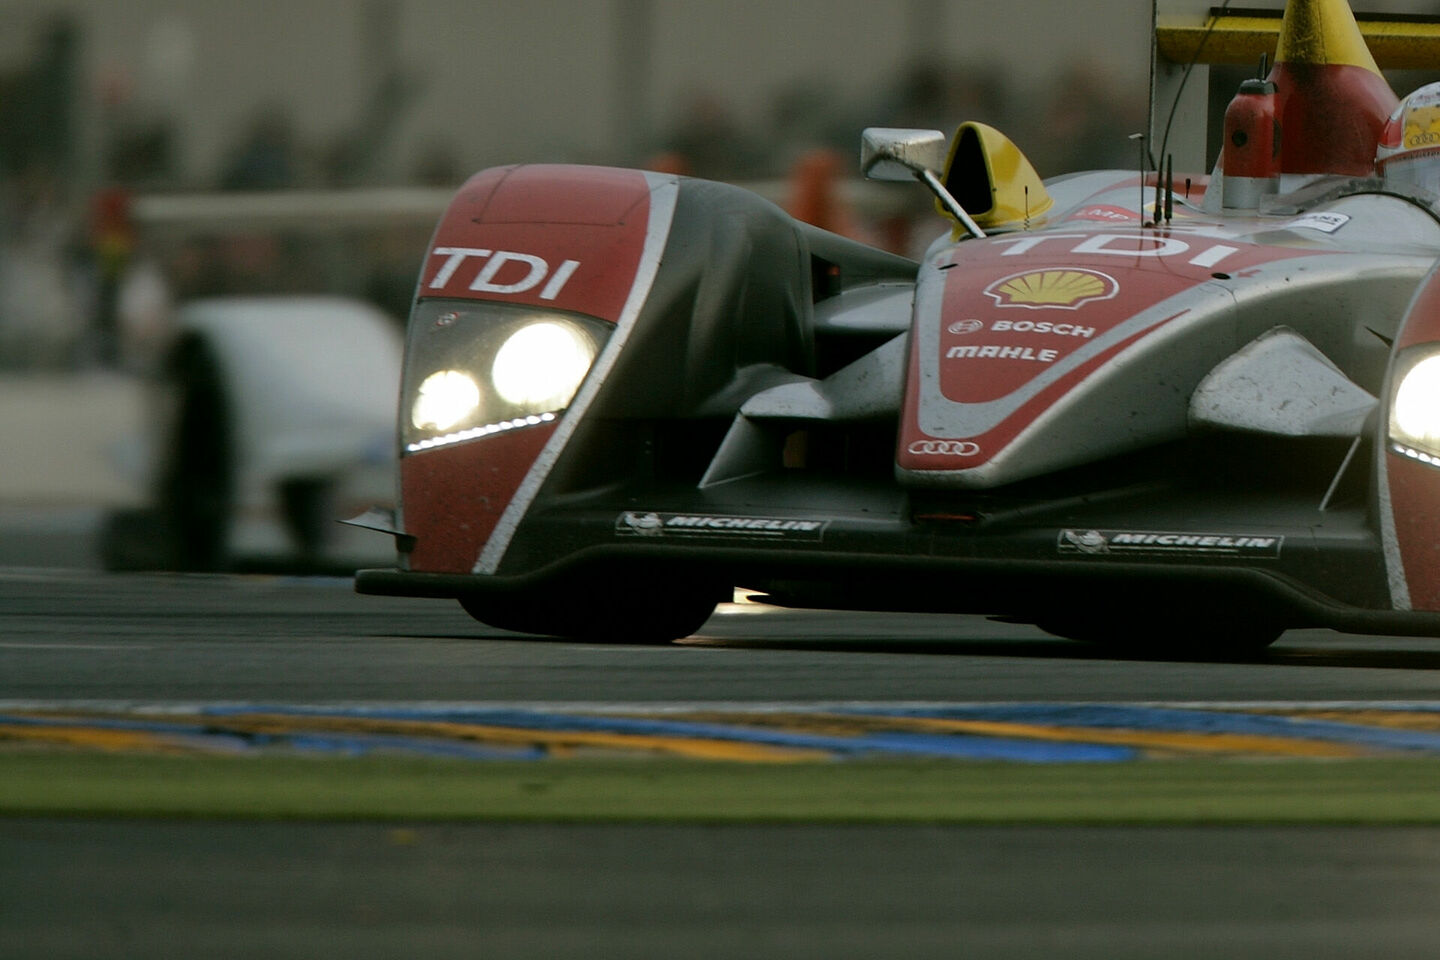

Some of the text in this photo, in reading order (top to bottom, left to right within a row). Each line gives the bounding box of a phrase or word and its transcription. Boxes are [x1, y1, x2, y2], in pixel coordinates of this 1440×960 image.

[991, 234, 1241, 268] TDI
[428, 247, 582, 300] TDI
[991, 320, 1096, 339] BOSCH
[946, 345, 1059, 362] MAHLE
[666, 515, 823, 531] MICHELIN
[1111, 532, 1276, 548] MICHELIN
